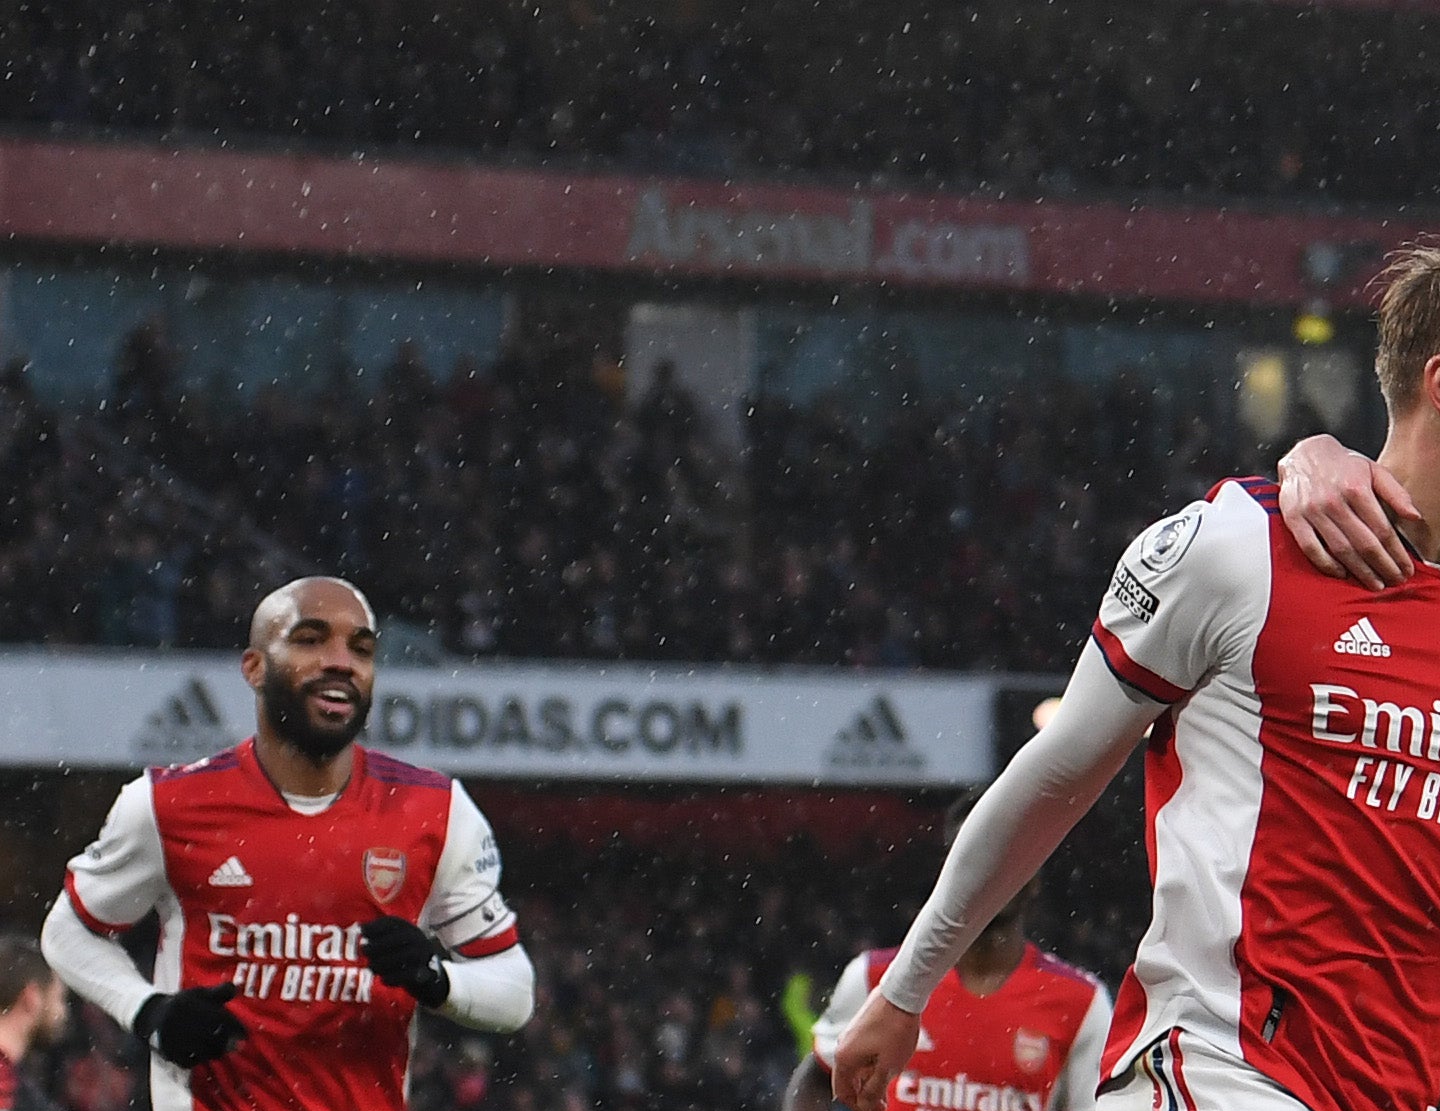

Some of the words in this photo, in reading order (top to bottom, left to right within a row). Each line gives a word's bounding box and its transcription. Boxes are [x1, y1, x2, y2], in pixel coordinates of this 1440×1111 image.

[1333, 640, 1392, 657] adidas
[364, 690, 745, 760] DIDAS.COM
[1346, 755, 1415, 812] FLY
[207, 912, 369, 961] Emirat
[232, 962, 278, 999] FLY
[279, 964, 374, 1003] BETTER
